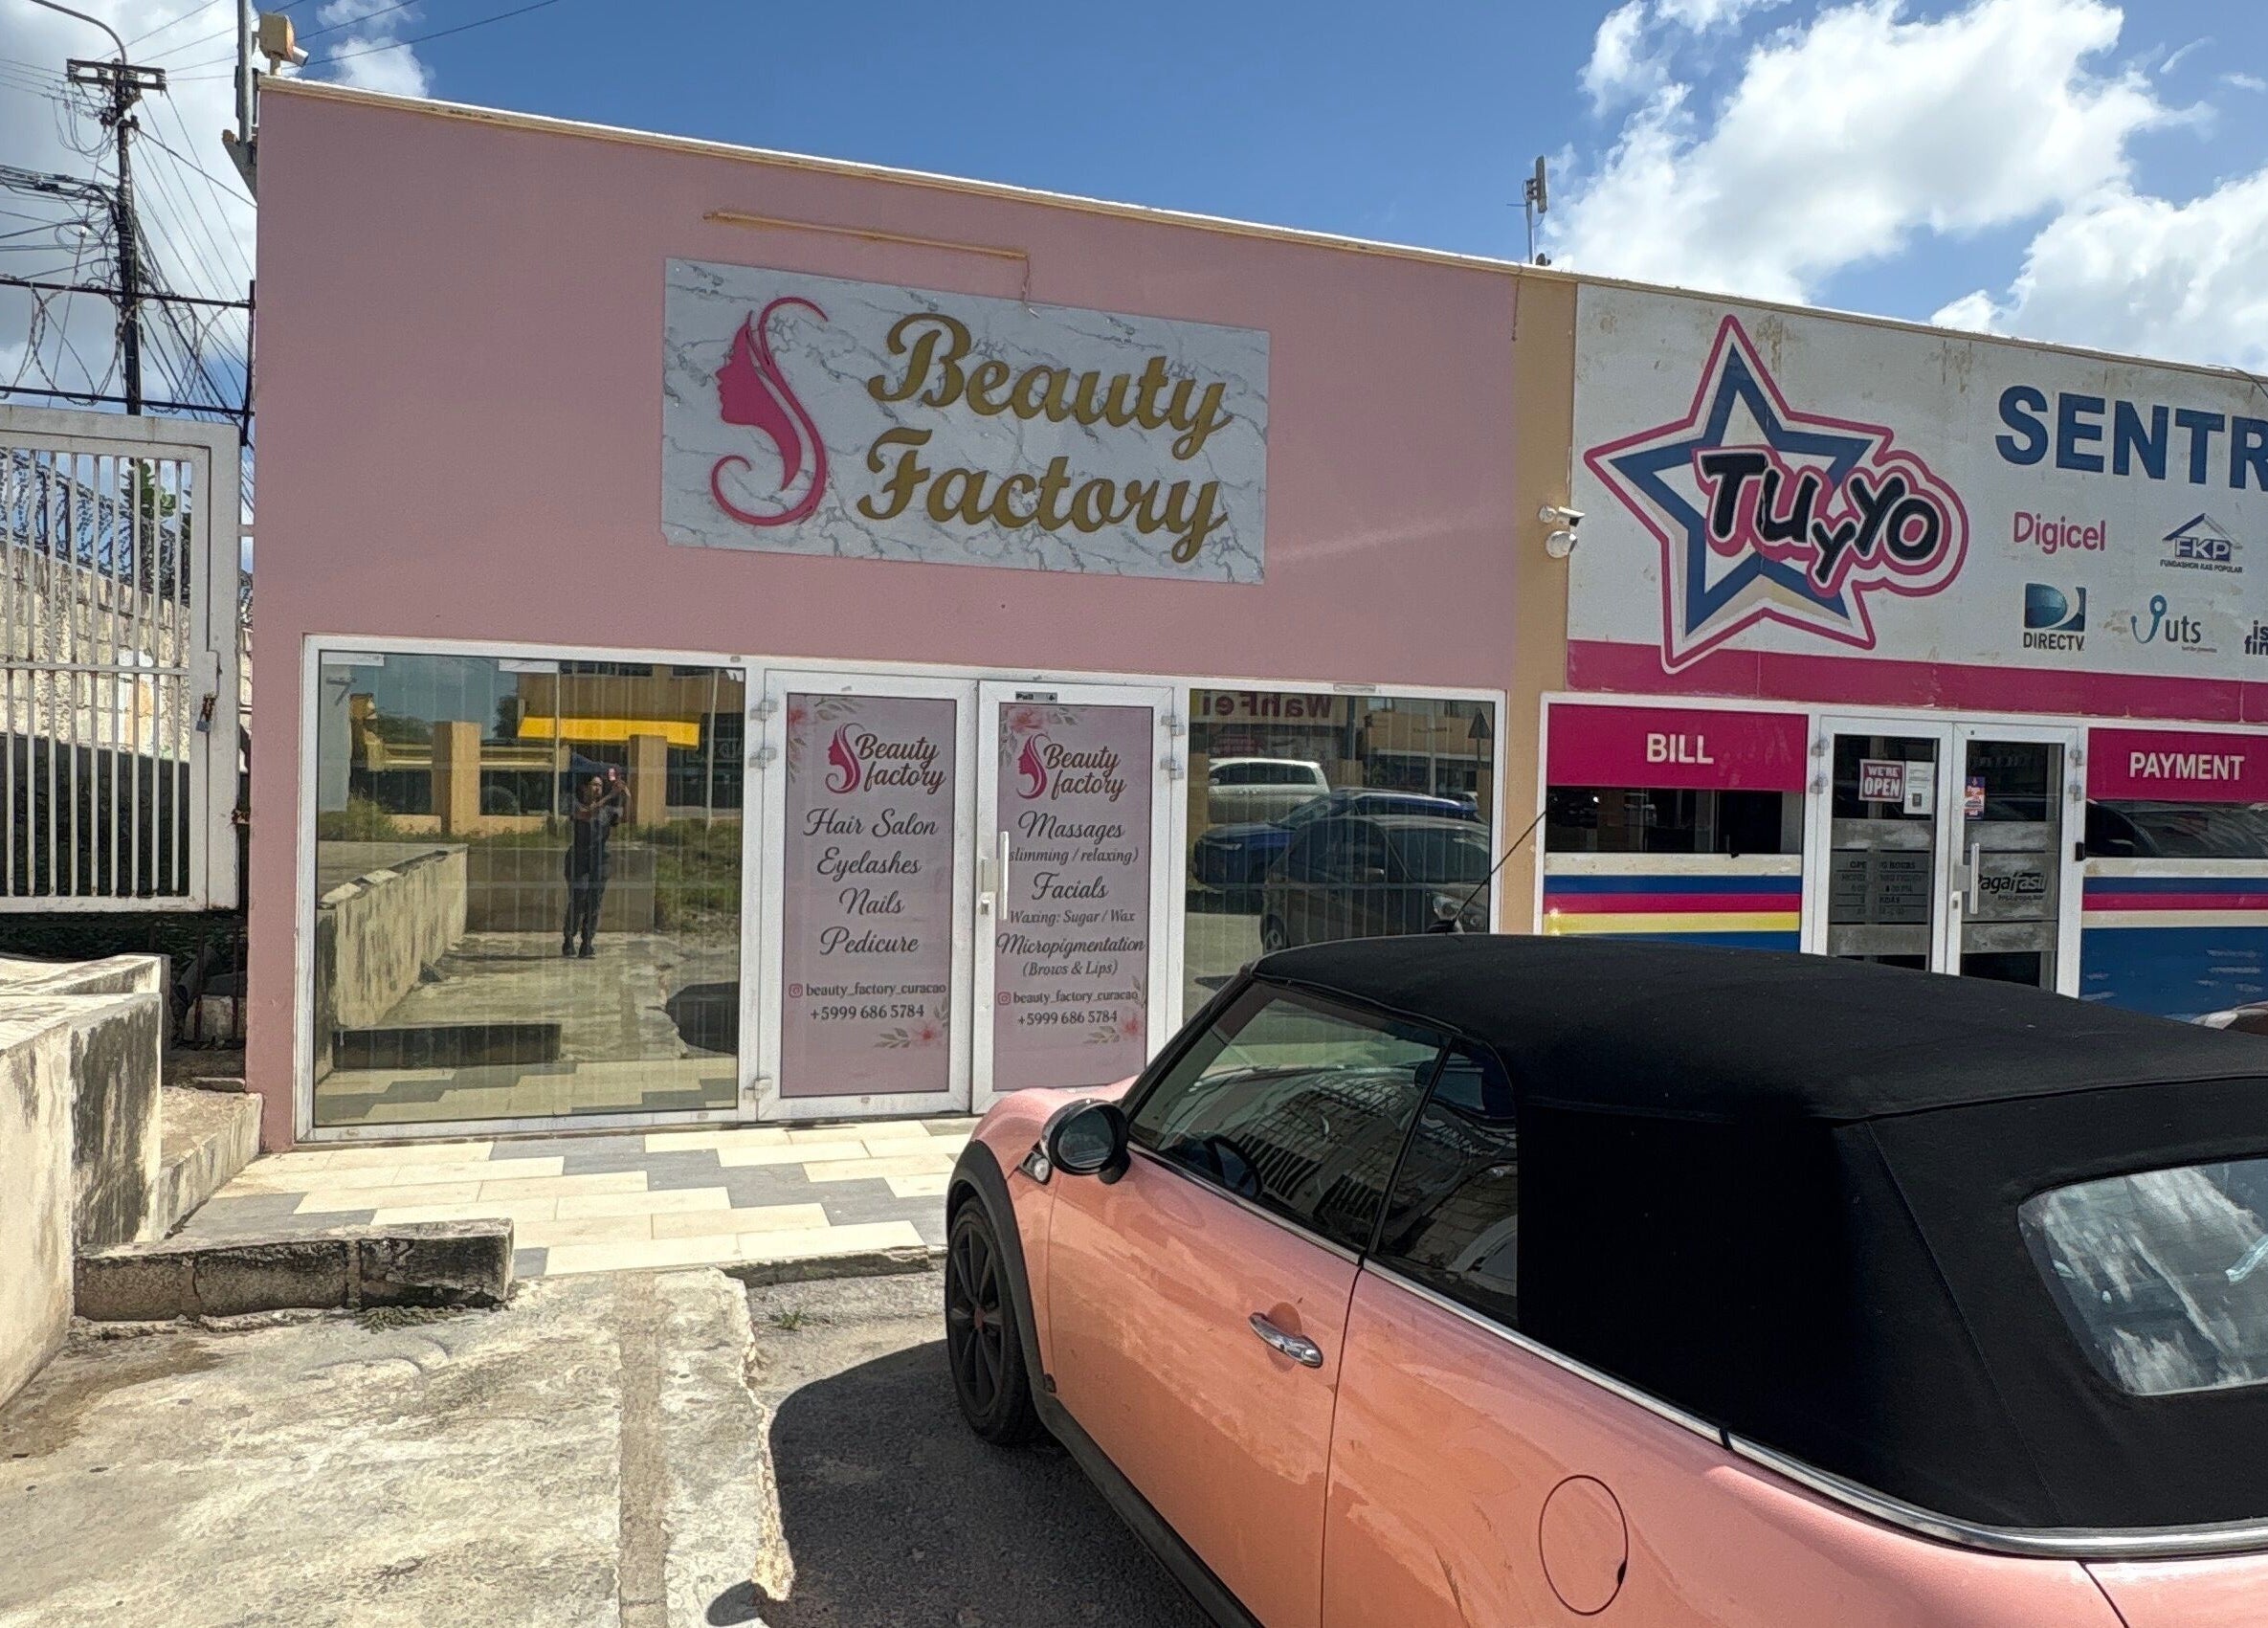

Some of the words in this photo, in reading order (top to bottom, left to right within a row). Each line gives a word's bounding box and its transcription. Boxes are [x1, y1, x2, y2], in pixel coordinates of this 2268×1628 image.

[867, 311, 1234, 460] Beauty
[856, 427, 1229, 563] Factory
[2012, 511, 2105, 554] Digicel
[2175, 537, 2231, 560] FKP
[2023, 632, 2085, 652] DIRECTV
[855, 732, 940, 769] Beauty
[1043, 743, 1122, 778] Beauty
[1646, 732, 1714, 765] BILL
[863, 760, 946, 795] factory
[1866, 765, 1901, 778] WE'RE
[2129, 751, 2245, 781] PAYMENT
[1051, 769, 1127, 802] factory
[1864, 778, 1901, 797] OPEN
[803, 807, 865, 836] Hair
[872, 807, 938, 838] Salon
[1017, 810, 1125, 845] Massages
[816, 846, 922, 882] Eyelashes
[1080, 846, 1139, 866] relaxing)
[1031, 871, 1109, 901] Facials
[838, 887, 905, 916] Nails
[1010, 910, 1061, 927] Waxing:
[1062, 910, 1100, 926] Sugar
[1110, 909, 1136, 923] Wax
[819, 926, 920, 956] Pedicure
[996, 932, 1146, 959] Micropigmentation
[1022, 961, 1068, 978] (Brows
[1070, 962, 1081, 975] &
[1085, 959, 1119, 978] Lips)
[806, 982, 946, 998] beauty_factory_curacao
[810, 1005, 856, 1020] +5999
[859, 1005, 888, 1019] 686
[890, 1004, 925, 1018] 5784
[1017, 1012, 1058, 1026] +5999
[1060, 1012, 1085, 1024] 686
[1087, 1010, 1118, 1023] 5784
